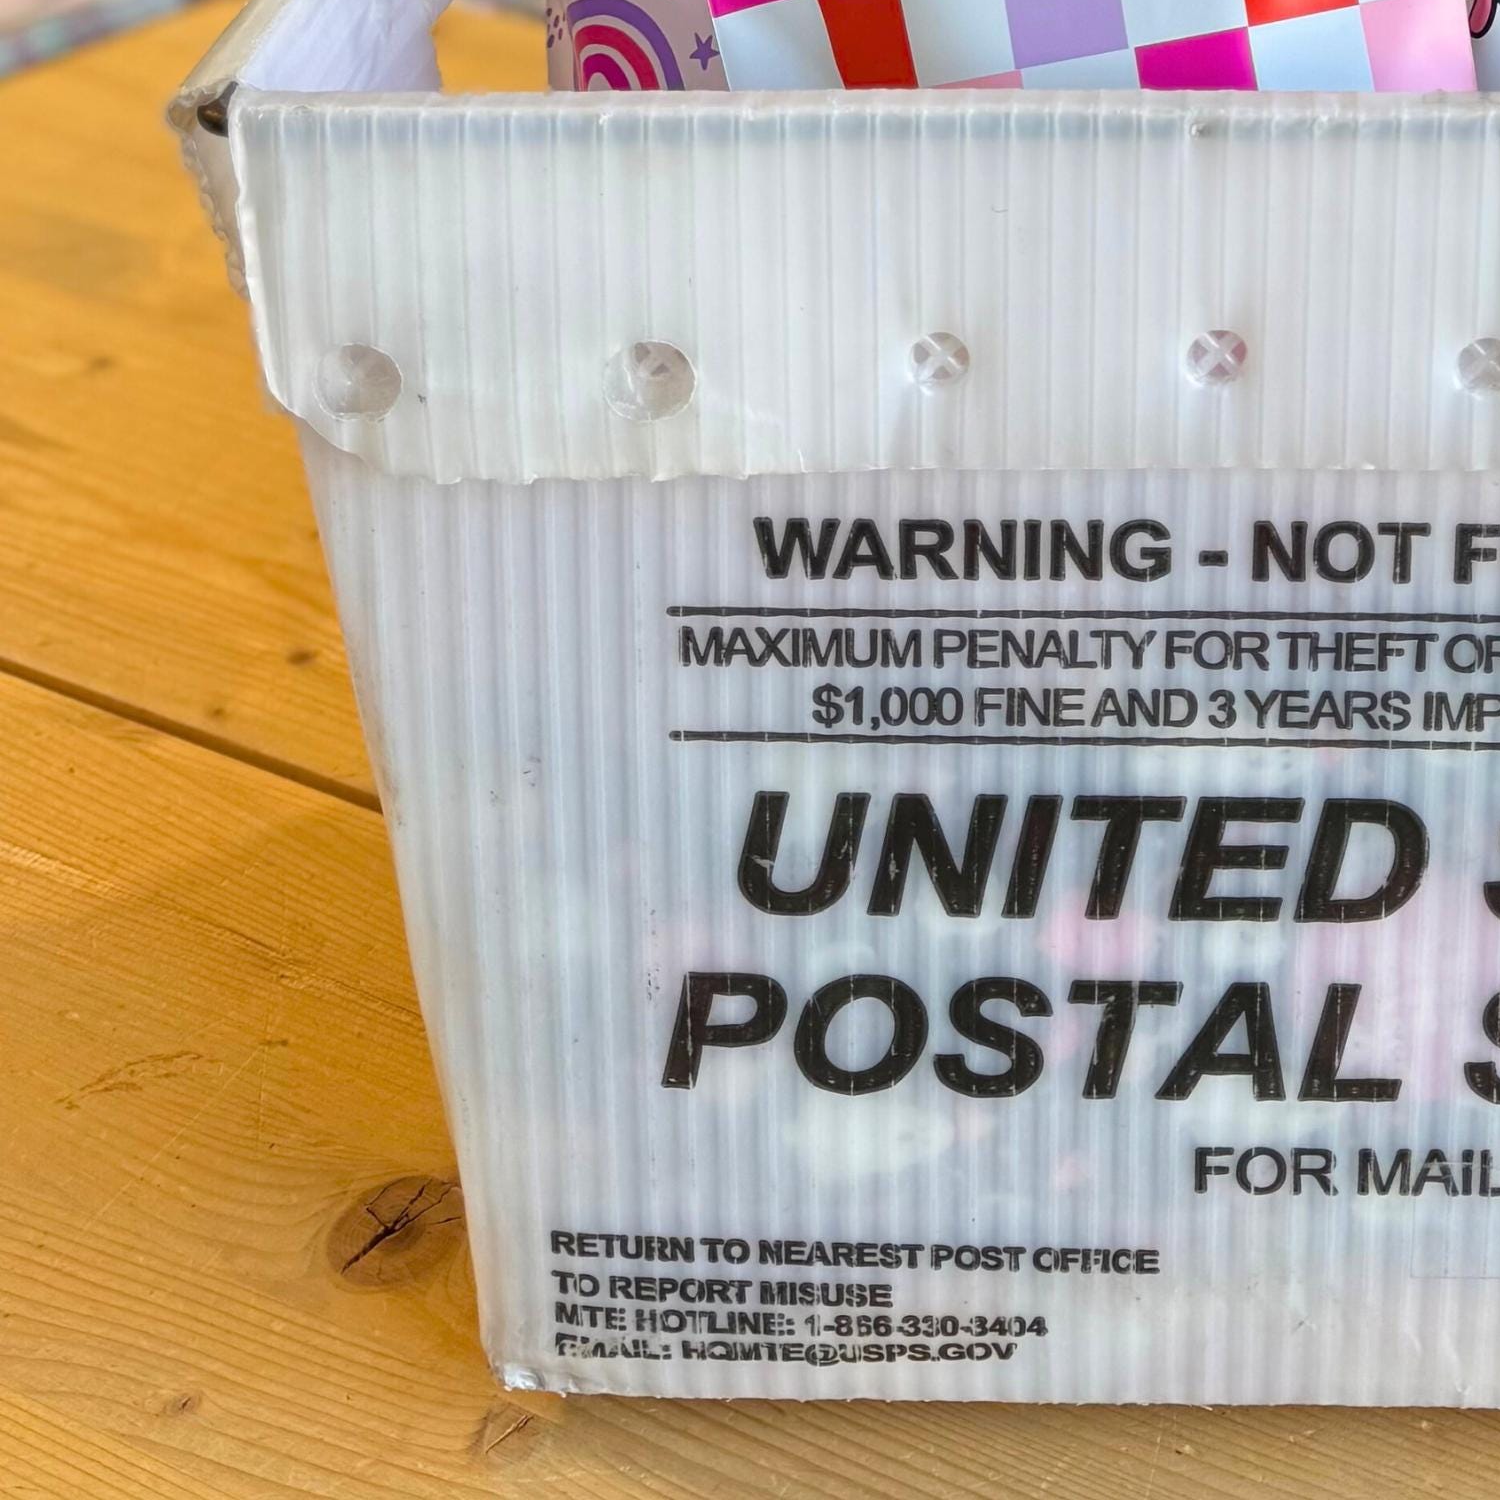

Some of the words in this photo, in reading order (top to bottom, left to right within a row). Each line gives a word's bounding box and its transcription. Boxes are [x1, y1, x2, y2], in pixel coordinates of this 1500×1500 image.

[753, 516, 1173, 581] WARNING
[1251, 520, 1432, 584] NOT
[679, 625, 922, 669] MAXIMUM
[933, 629, 1157, 670] PENALTY
[1165, 630, 1270, 671] FOR
[1276, 631, 1439, 673] THEFT
[812, 683, 964, 731] $1,000
[975, 686, 1085, 728] FINE
[1091, 687, 1198, 728] AND
[1208, 689, 1237, 729] 3
[1244, 689, 1411, 731] YEARS
[737, 790, 1430, 923] UNITED
[661, 971, 1403, 1103] POSTAL
[1194, 1146, 1338, 1197] FOR
[550, 1230, 695, 1263] RETURN
[700, 1237, 750, 1264] TO
[758, 1240, 924, 1269] NEAREST
[930, 1244, 1026, 1272] POST
[1032, 1247, 1160, 1274] OFFICE
[551, 1270, 600, 1297] TO
[609, 1275, 753, 1304] REPORT
[759, 1280, 893, 1308] MISUSE
